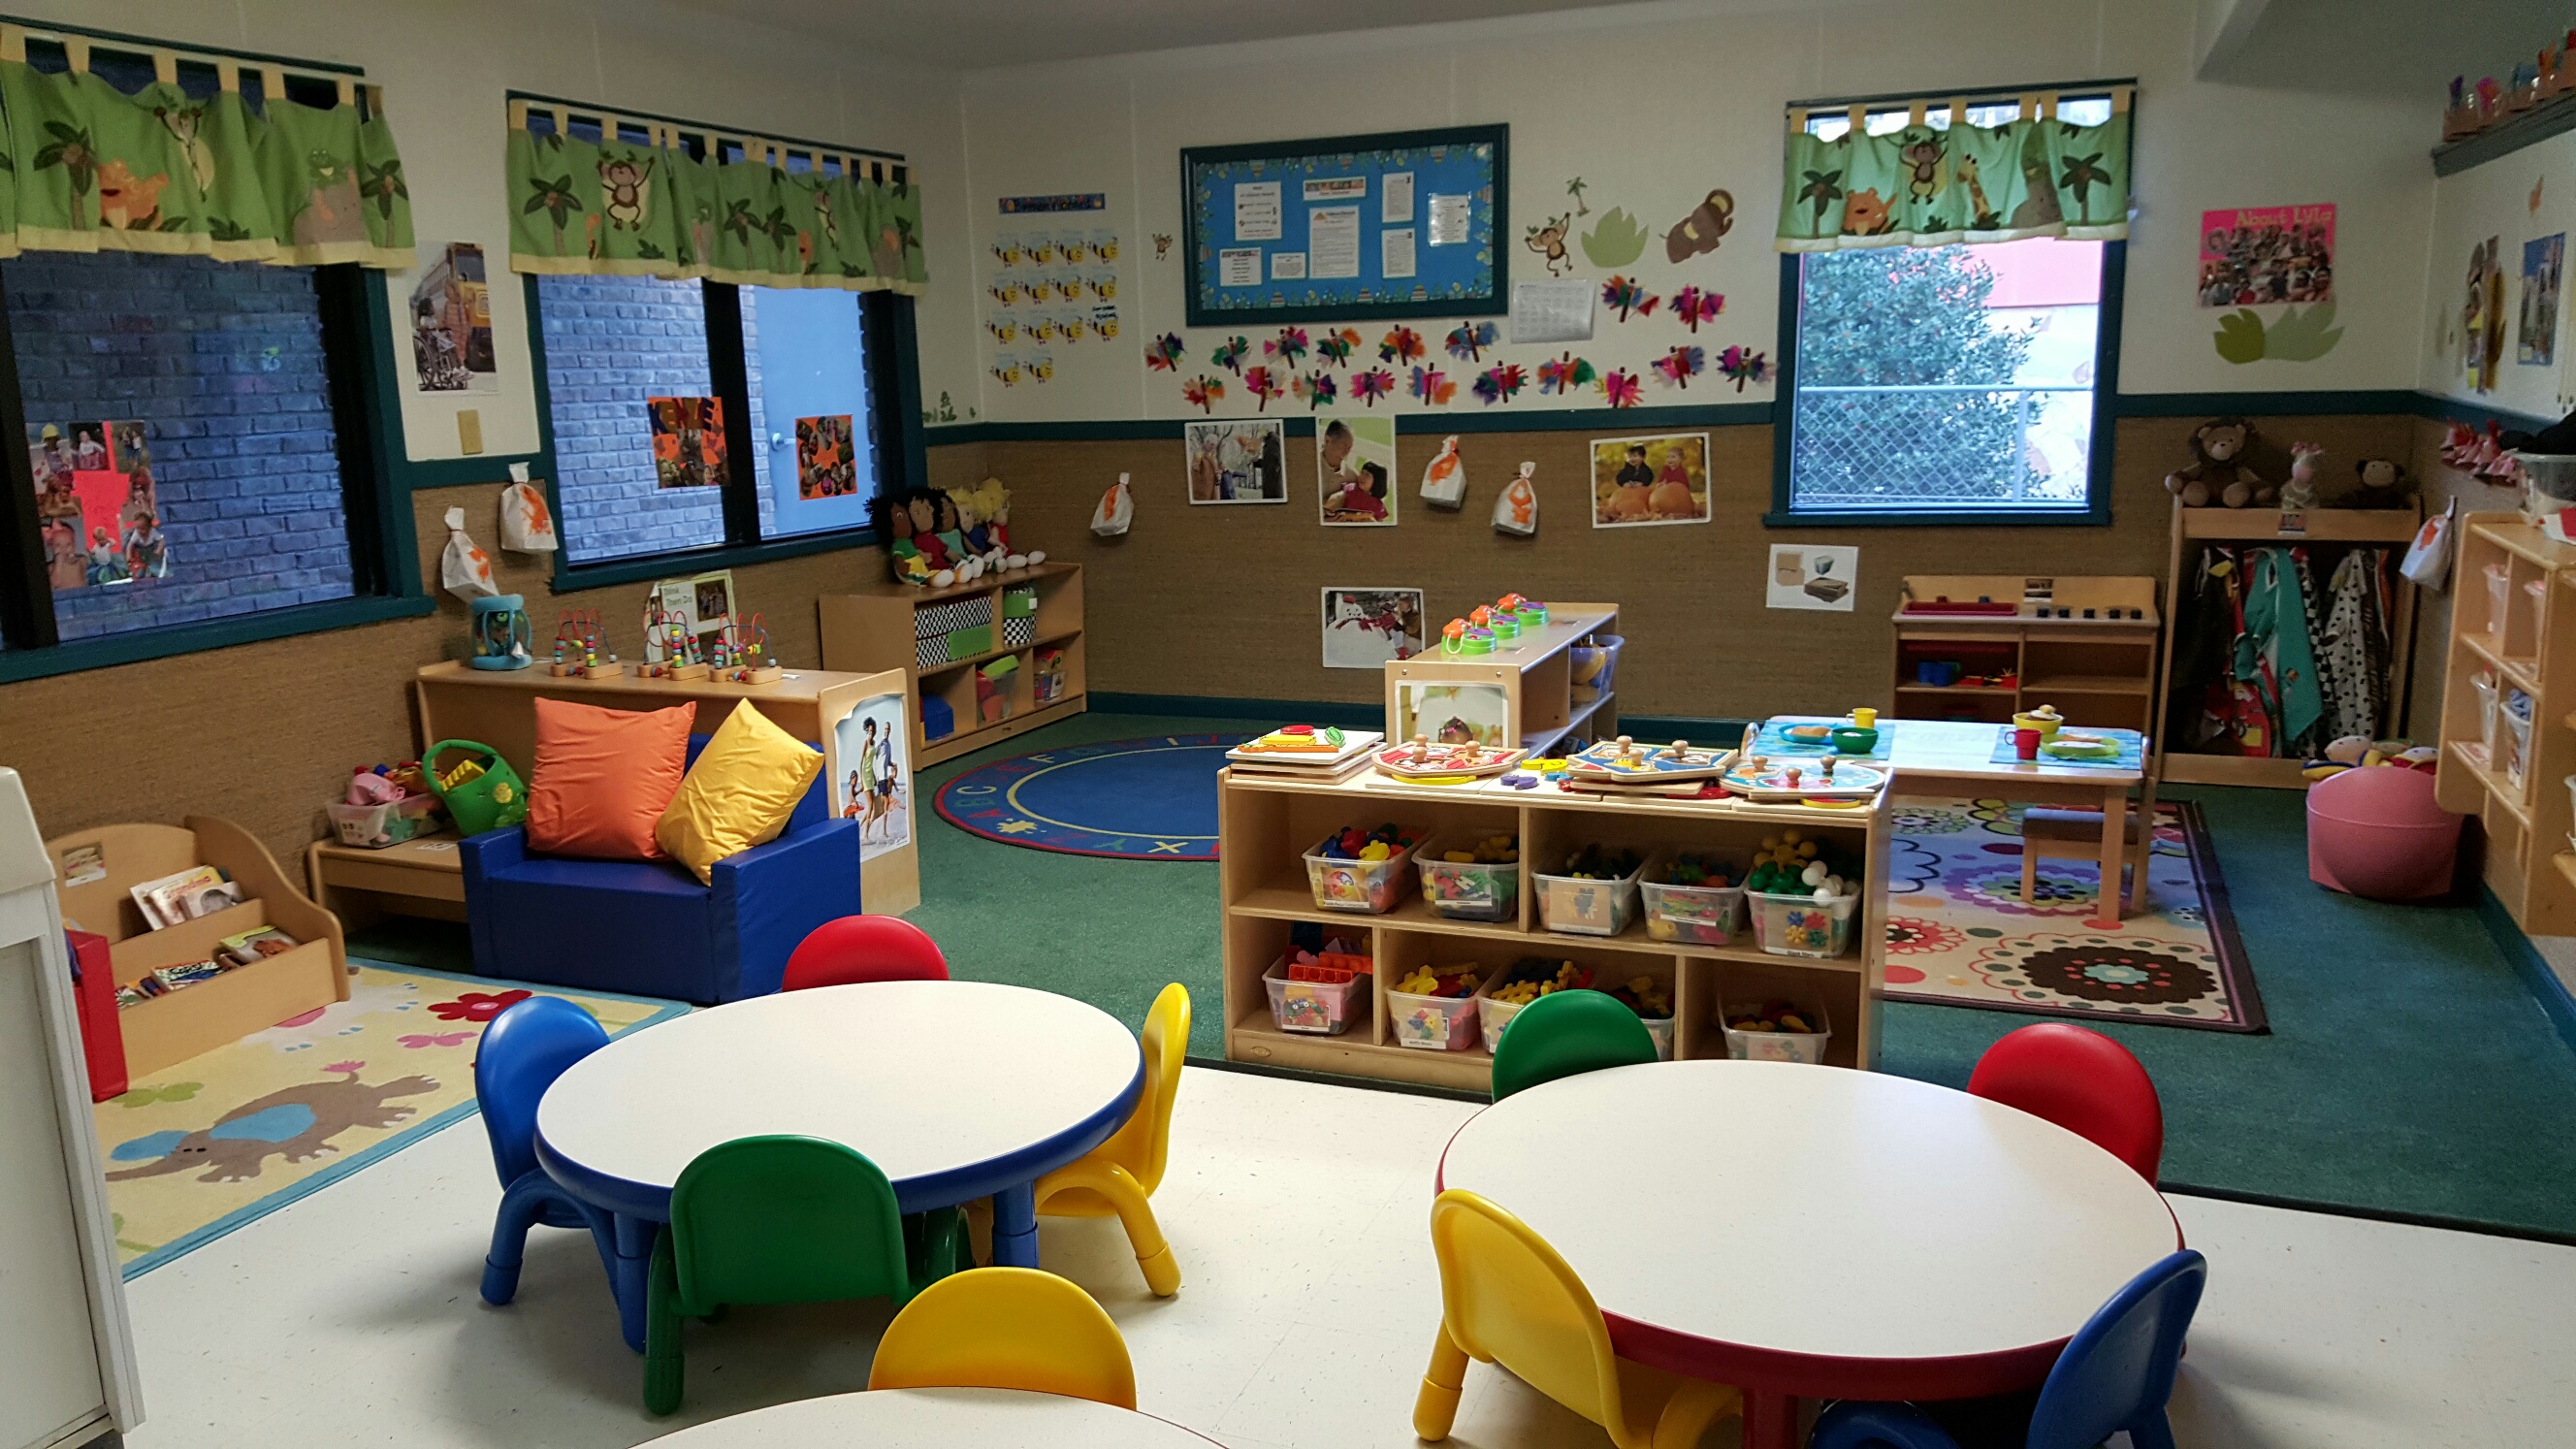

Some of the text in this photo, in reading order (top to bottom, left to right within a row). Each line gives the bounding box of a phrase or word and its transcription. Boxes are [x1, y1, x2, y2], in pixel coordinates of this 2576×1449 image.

[2235, 209, 2287, 226] About
[1196, 734, 1219, 745] J
[1028, 754, 1056, 764] F
[955, 786, 998, 795] C
[968, 808, 1013, 819] A
[1147, 841, 1190, 853] X
